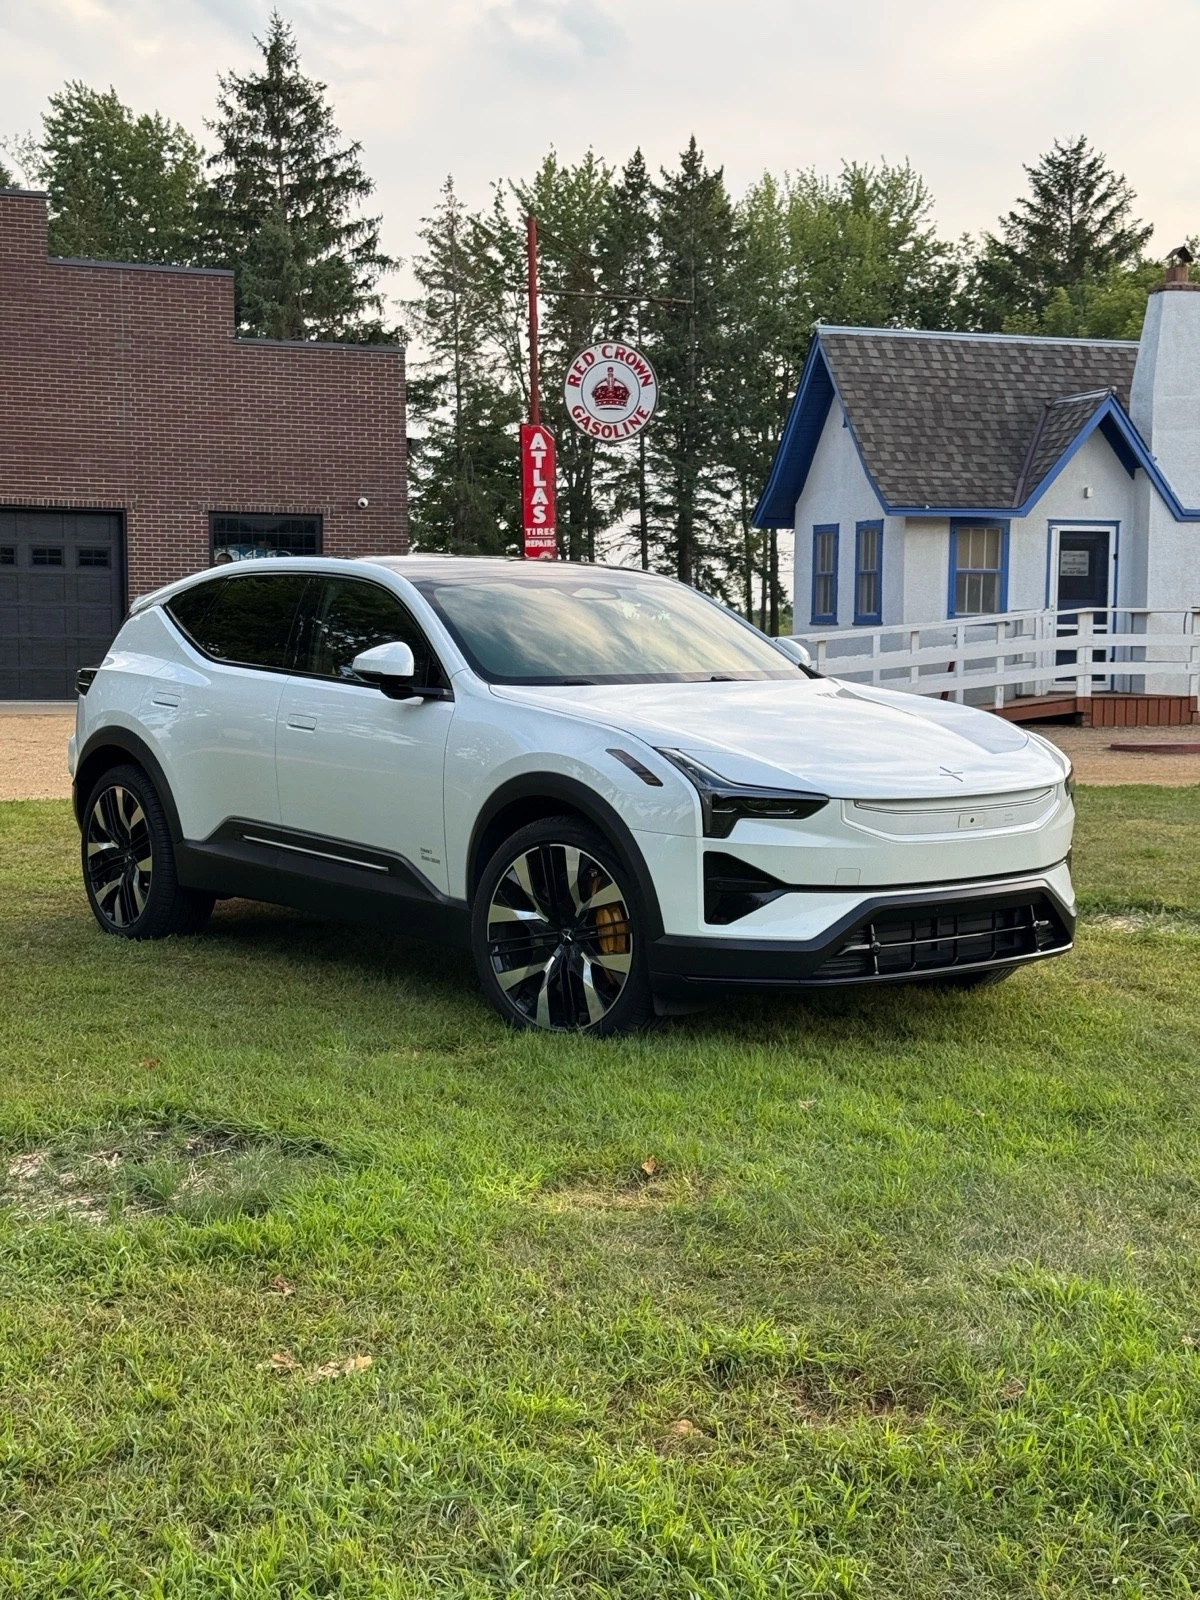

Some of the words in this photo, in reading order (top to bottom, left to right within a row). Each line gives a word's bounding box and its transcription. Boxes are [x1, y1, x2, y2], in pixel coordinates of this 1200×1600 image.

[567, 351, 595, 388] RED
[601, 345, 653, 388] CROWN
[571, 405, 650, 439] GASOLINE
[529, 432, 549, 524] ATLAS
[525, 527, 555, 537] TIRES
[525, 539, 556, 548] REPAIRS
